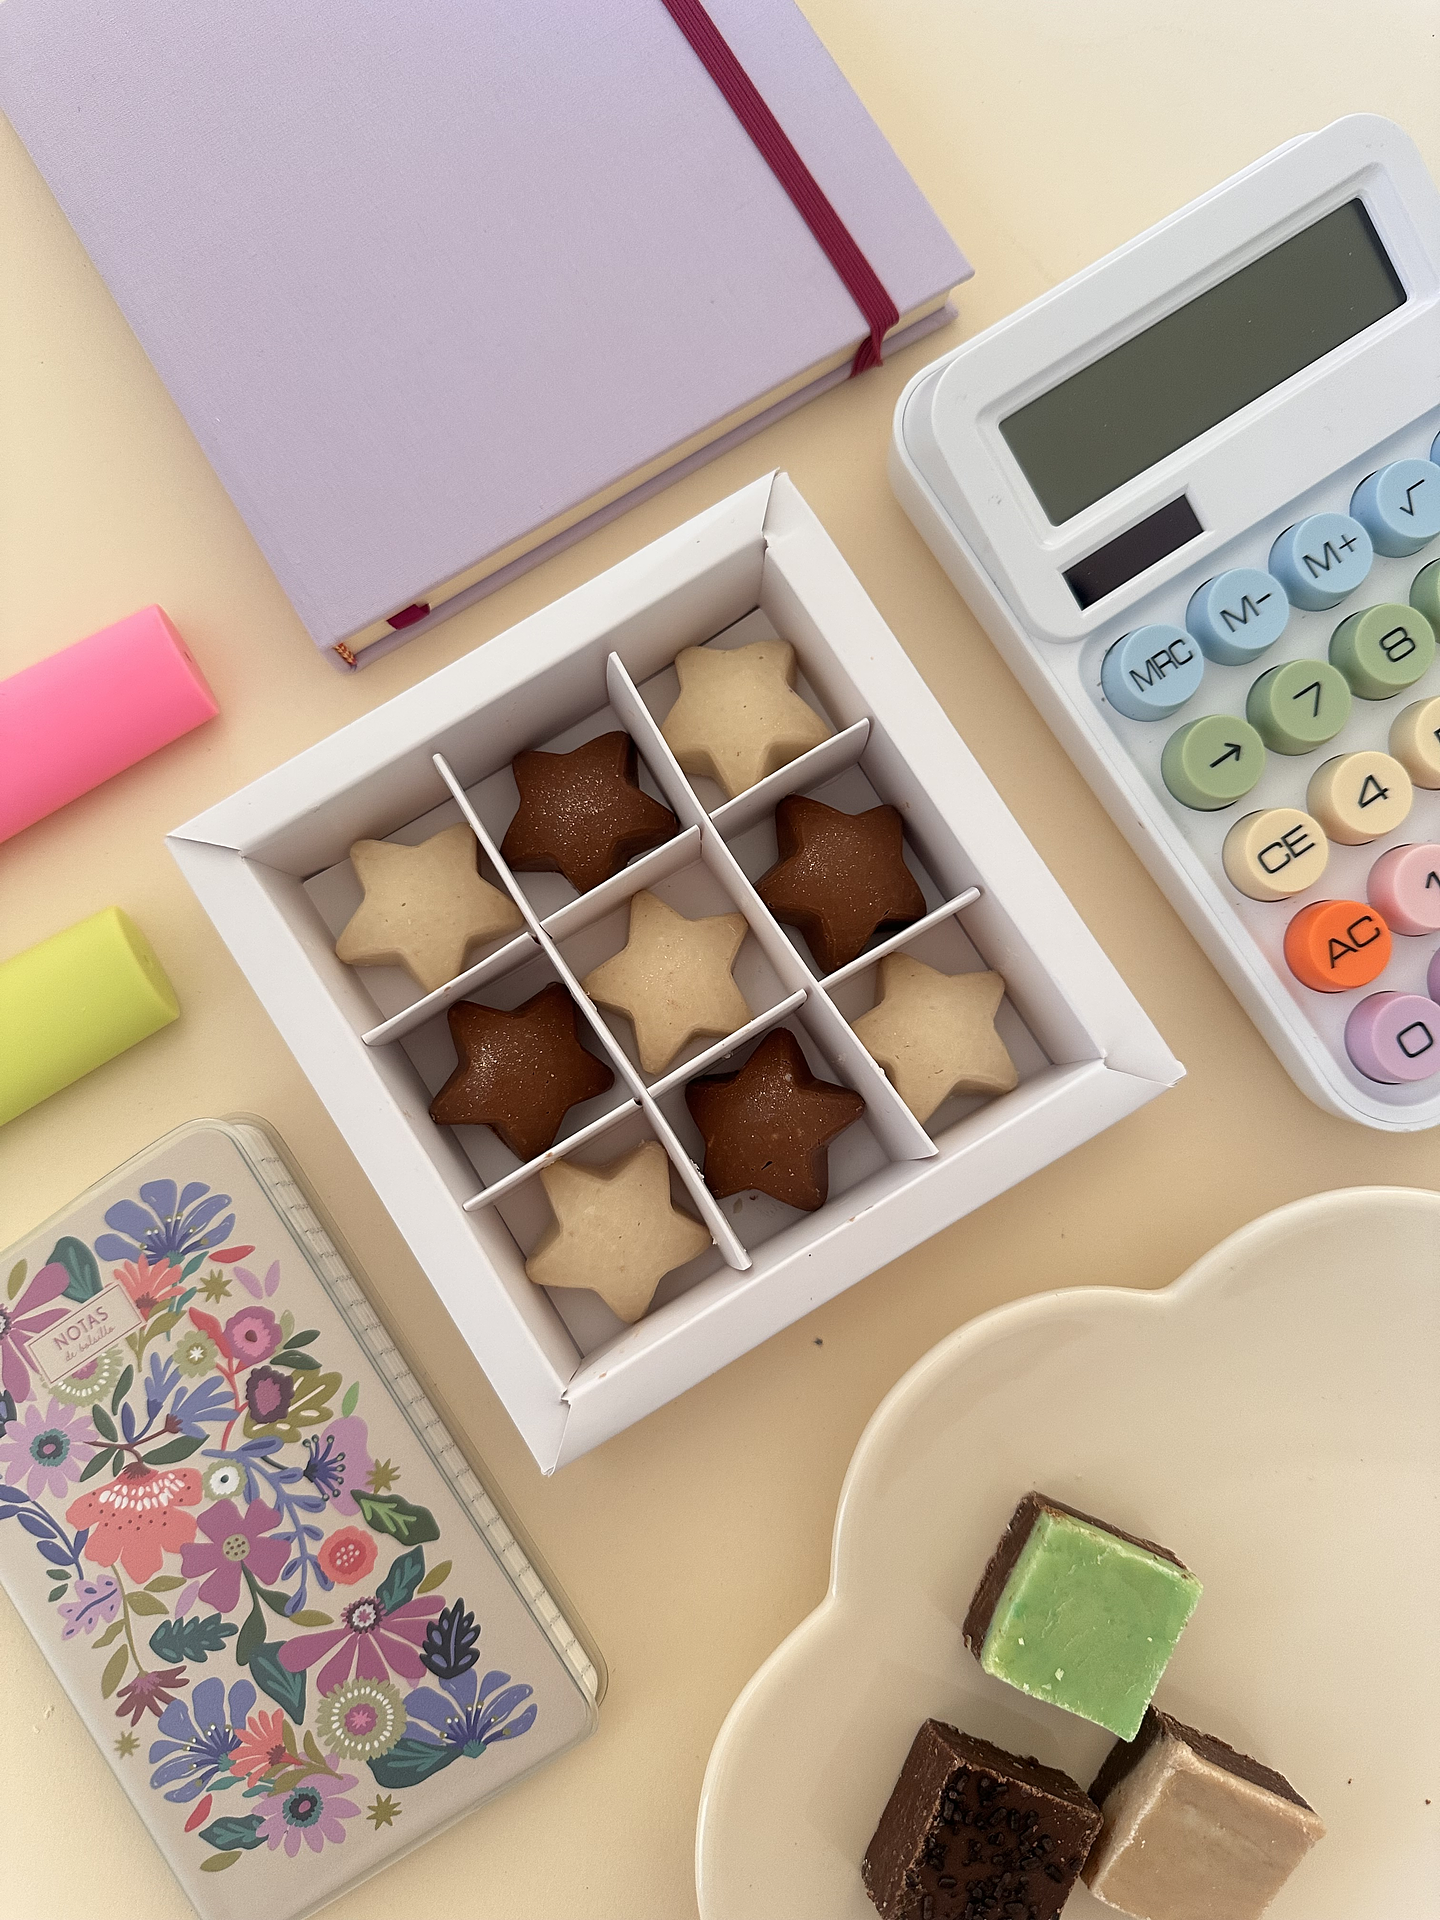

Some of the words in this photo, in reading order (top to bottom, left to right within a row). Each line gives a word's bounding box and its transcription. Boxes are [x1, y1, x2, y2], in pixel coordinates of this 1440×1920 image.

[1302, 534, 1358, 578] M+
[1219, 593, 1271, 633] M-
[1128, 638, 1194, 692] MRC
[1378, 626, 1416, 663] 8
[1292, 681, 1321, 717] 7
[1357, 774, 1389, 808] 4
[1257, 824, 1316, 874] CE
[1327, 915, 1380, 969] AC
[53, 1306, 108, 1350] NOTAS
[65, 1350, 78, 1361] de
